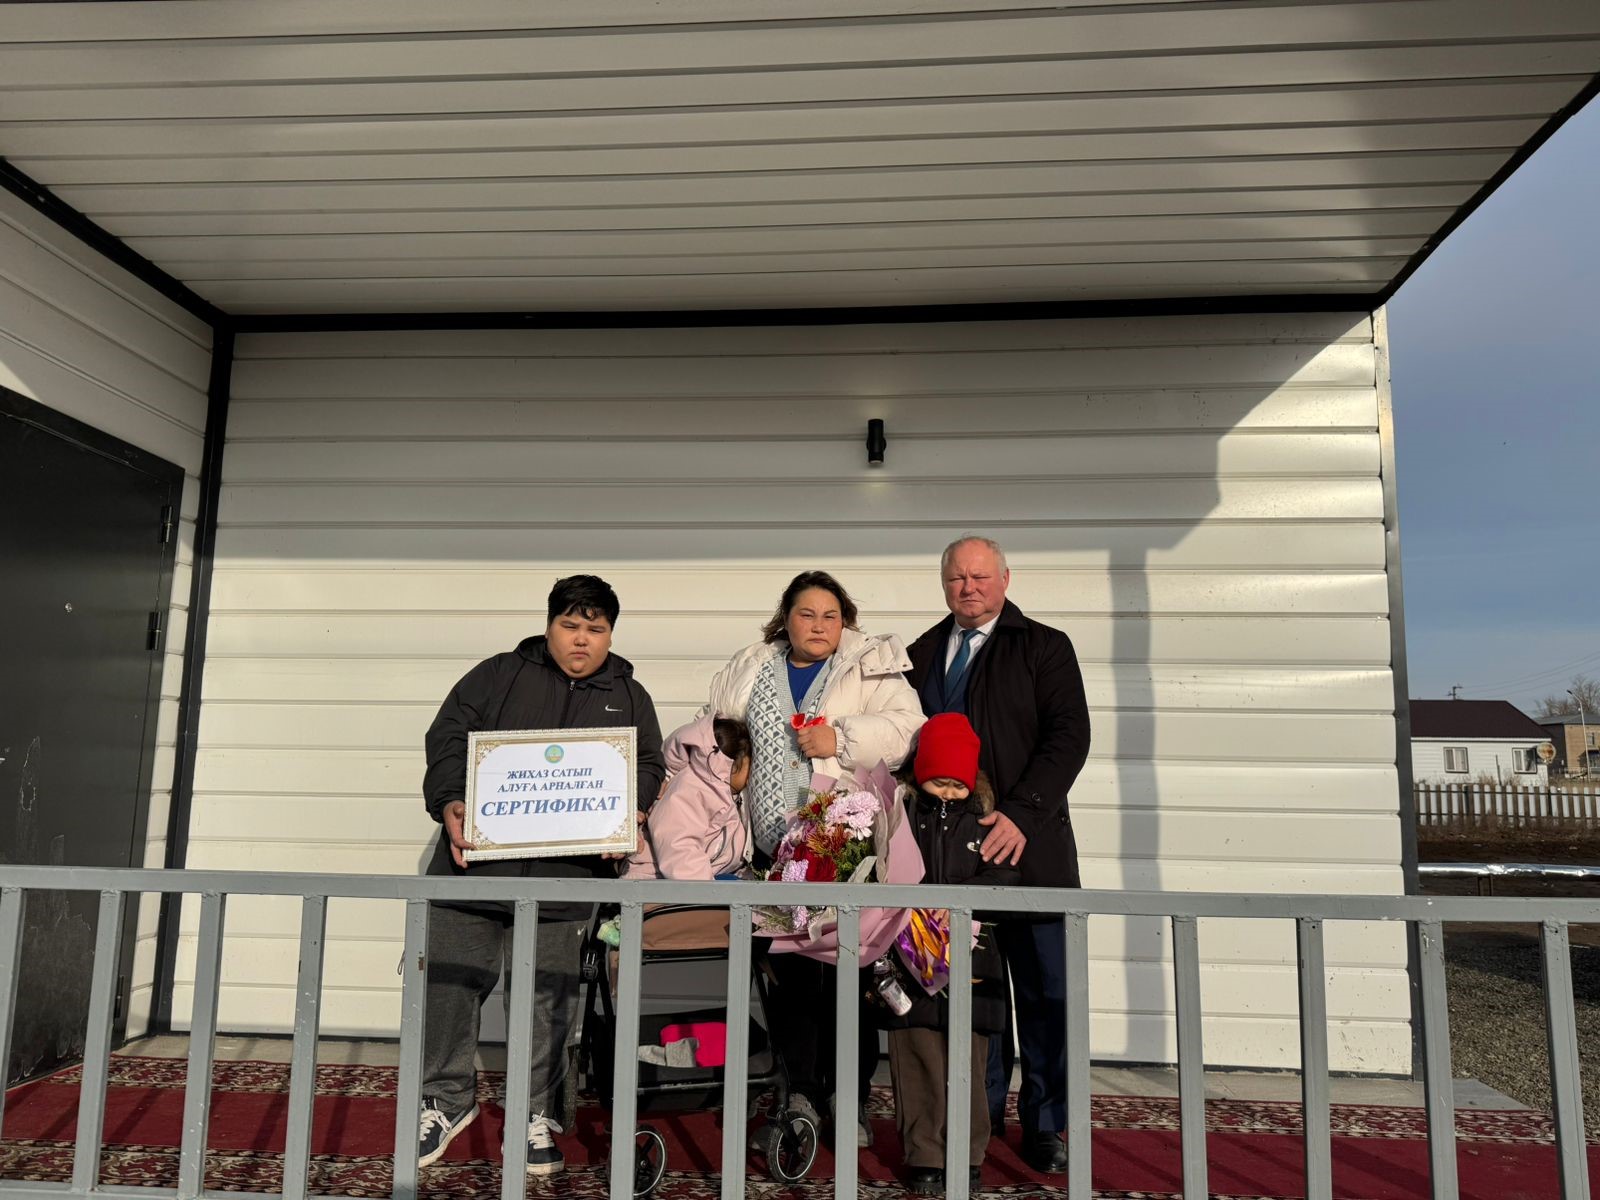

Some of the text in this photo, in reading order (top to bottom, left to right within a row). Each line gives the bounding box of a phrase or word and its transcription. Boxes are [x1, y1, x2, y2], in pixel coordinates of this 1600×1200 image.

[507, 767, 593, 780] ЖИХАЗ САТЫП
[497, 779, 604, 793] АЛУҒА АРНАЛҒАН
[481, 796, 620, 817] СЕРТИФИКАТ
